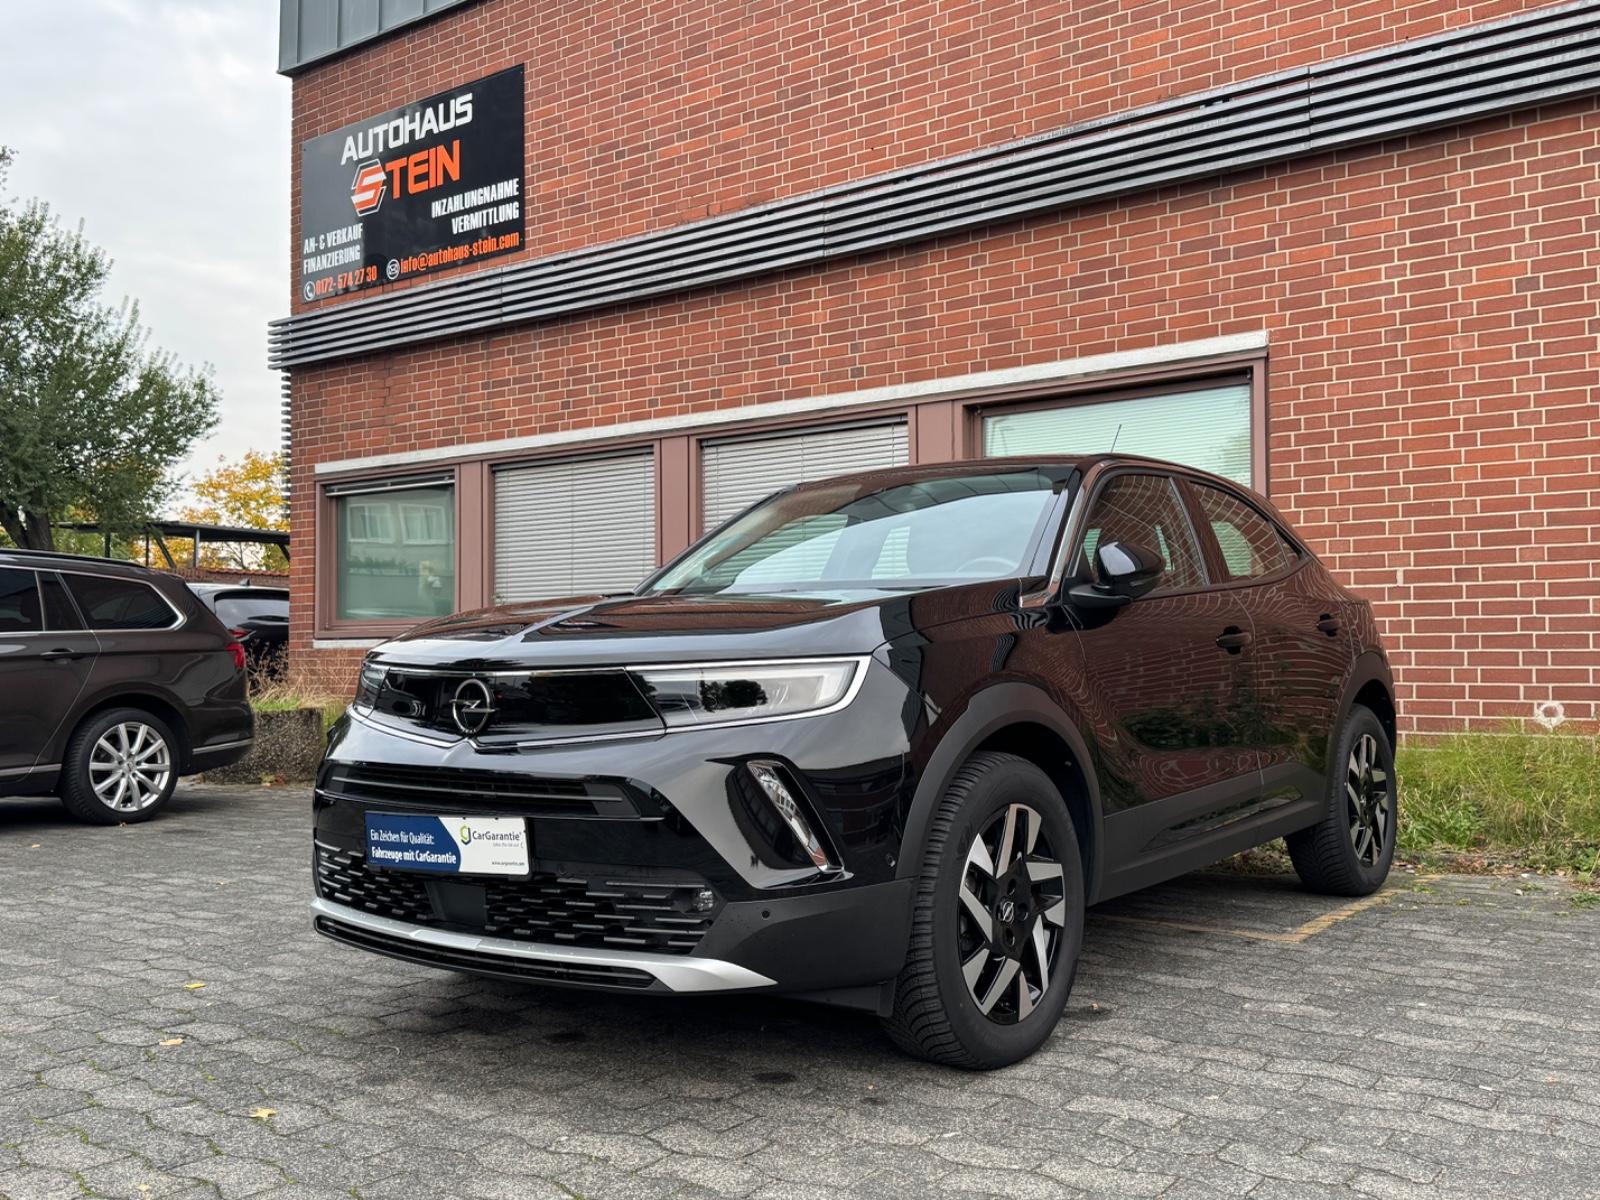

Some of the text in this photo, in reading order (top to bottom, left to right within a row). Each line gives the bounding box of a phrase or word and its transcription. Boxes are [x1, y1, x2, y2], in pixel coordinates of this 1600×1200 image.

[341, 93, 473, 166] AUTOHAUS
[351, 140, 461, 214] STEIN
[431, 178, 519, 218] INZAHLUNGNAHME
[452, 202, 519, 235] VERMITTLUNG
[304, 237, 318, 254] AN-
[327, 223, 363, 248] VERKAUF
[400, 232, 519, 274] info@autohaus-stein.com
[304, 246, 361, 275] FINANZIERUNG
[315, 265, 377, 295] 0172- 574 27 30
[379, 830, 400, 842] Zeichen
[400, 831, 409, 842] für
[410, 832, 435, 845] Qualität:
[472, 831, 520, 841] CarGarantie
[372, 847, 456, 864] Fahrzeuge mit CarGarantie
